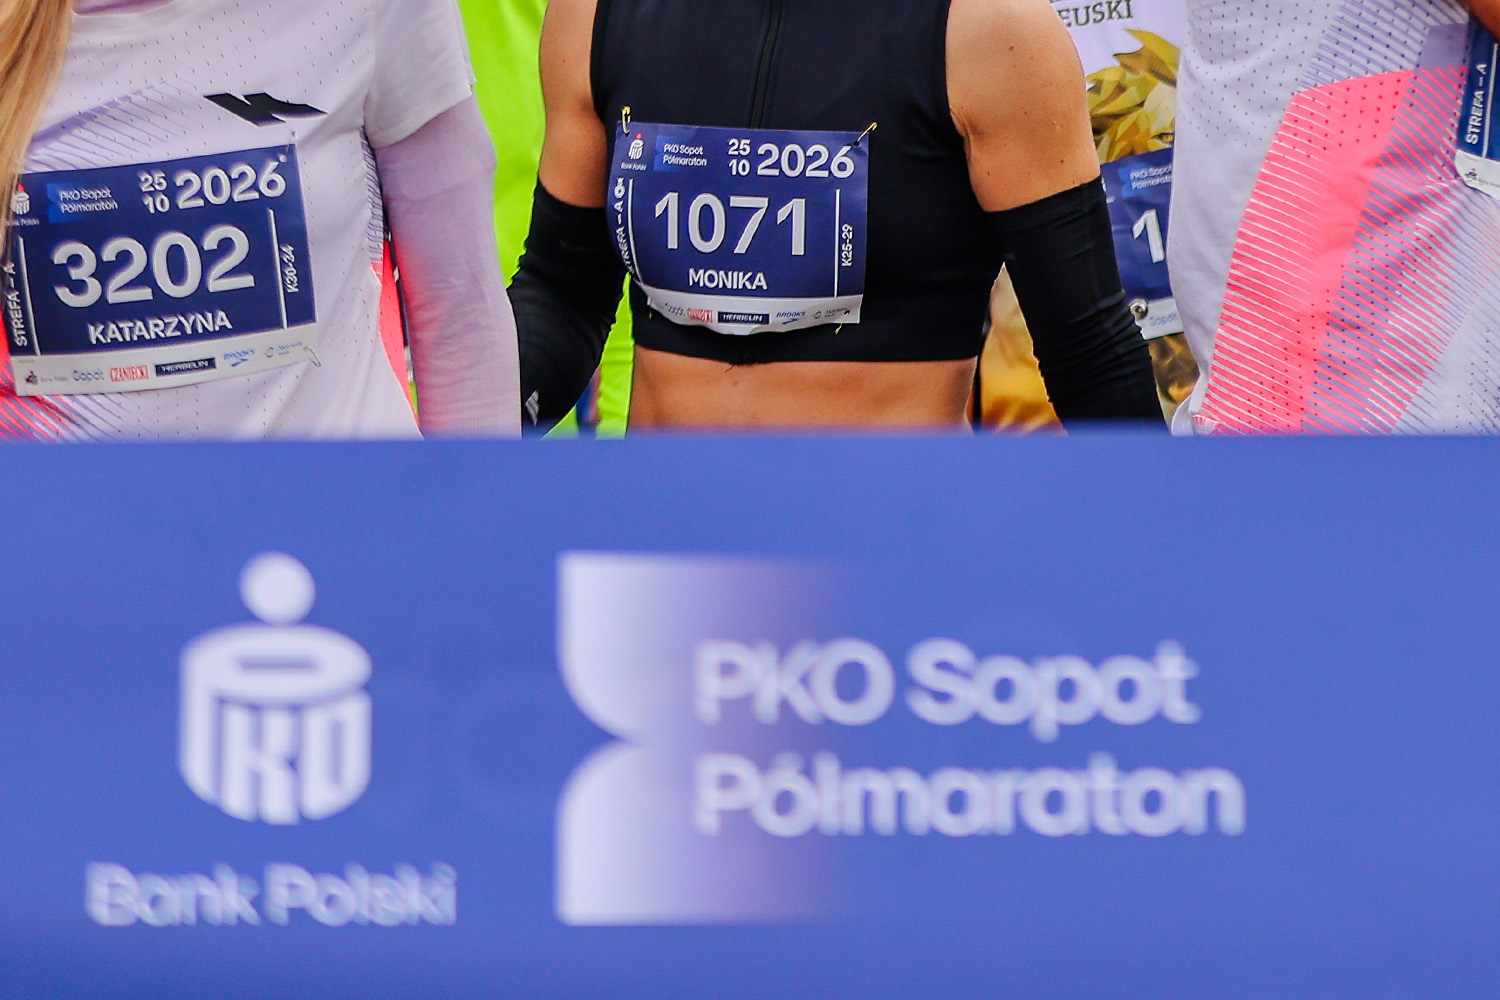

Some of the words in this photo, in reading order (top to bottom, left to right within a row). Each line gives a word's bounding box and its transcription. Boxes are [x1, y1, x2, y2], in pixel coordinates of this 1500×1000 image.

[1465, 89, 1485, 145] STREFA
[1475, 63, 1488, 75] A
[728, 138, 751, 156] 25
[728, 158, 751, 176] 10
[756, 143, 856, 179] 2026
[139, 170, 168, 193] 25
[144, 193, 171, 215] 10
[175, 161, 288, 210] 2026
[654, 191, 807, 257] 1071
[841, 224, 853, 267] K25-29
[1132, 208, 1166, 264] 1
[52, 224, 256, 308] 3202
[688, 268, 768, 290] MONIKA
[7, 291, 27, 347] STREFA
[88, 309, 234, 346] KATARZYNA
[693, 637, 896, 729] PKO
[905, 637, 1201, 742] Sopot
[85, 861, 259, 927] Bank
[268, 861, 458, 927] Polski
